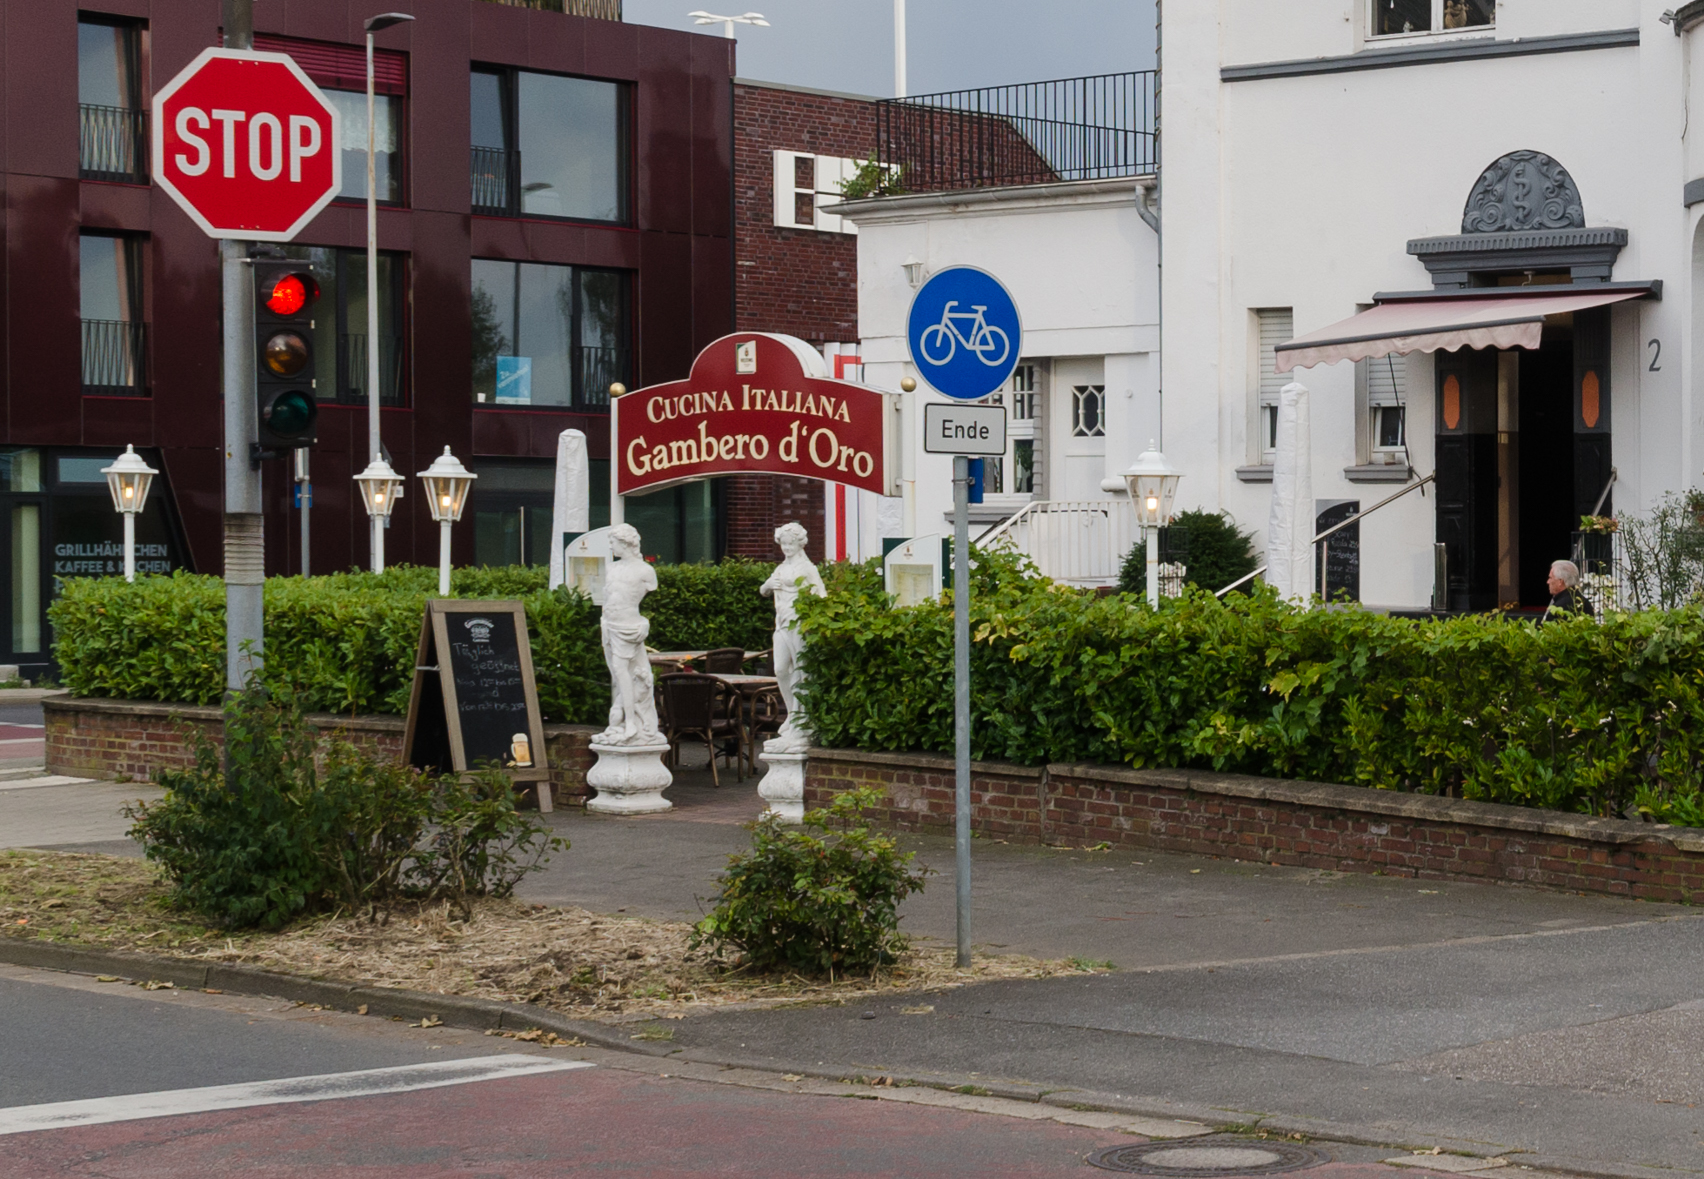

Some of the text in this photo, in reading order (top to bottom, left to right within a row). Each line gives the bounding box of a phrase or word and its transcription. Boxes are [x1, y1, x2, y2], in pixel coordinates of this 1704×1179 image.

[175, 106, 322, 183] STOP
[1648, 338, 1662, 372] 2
[646, 384, 851, 424] CUCINA ITALIANA
[942, 419, 990, 440] Ende
[626, 420, 875, 478] Gambero d'Oro
[54, 540, 168, 557] GRILLHÄHCHEN
[54, 560, 171, 573] KAFFEE & KCHEN
